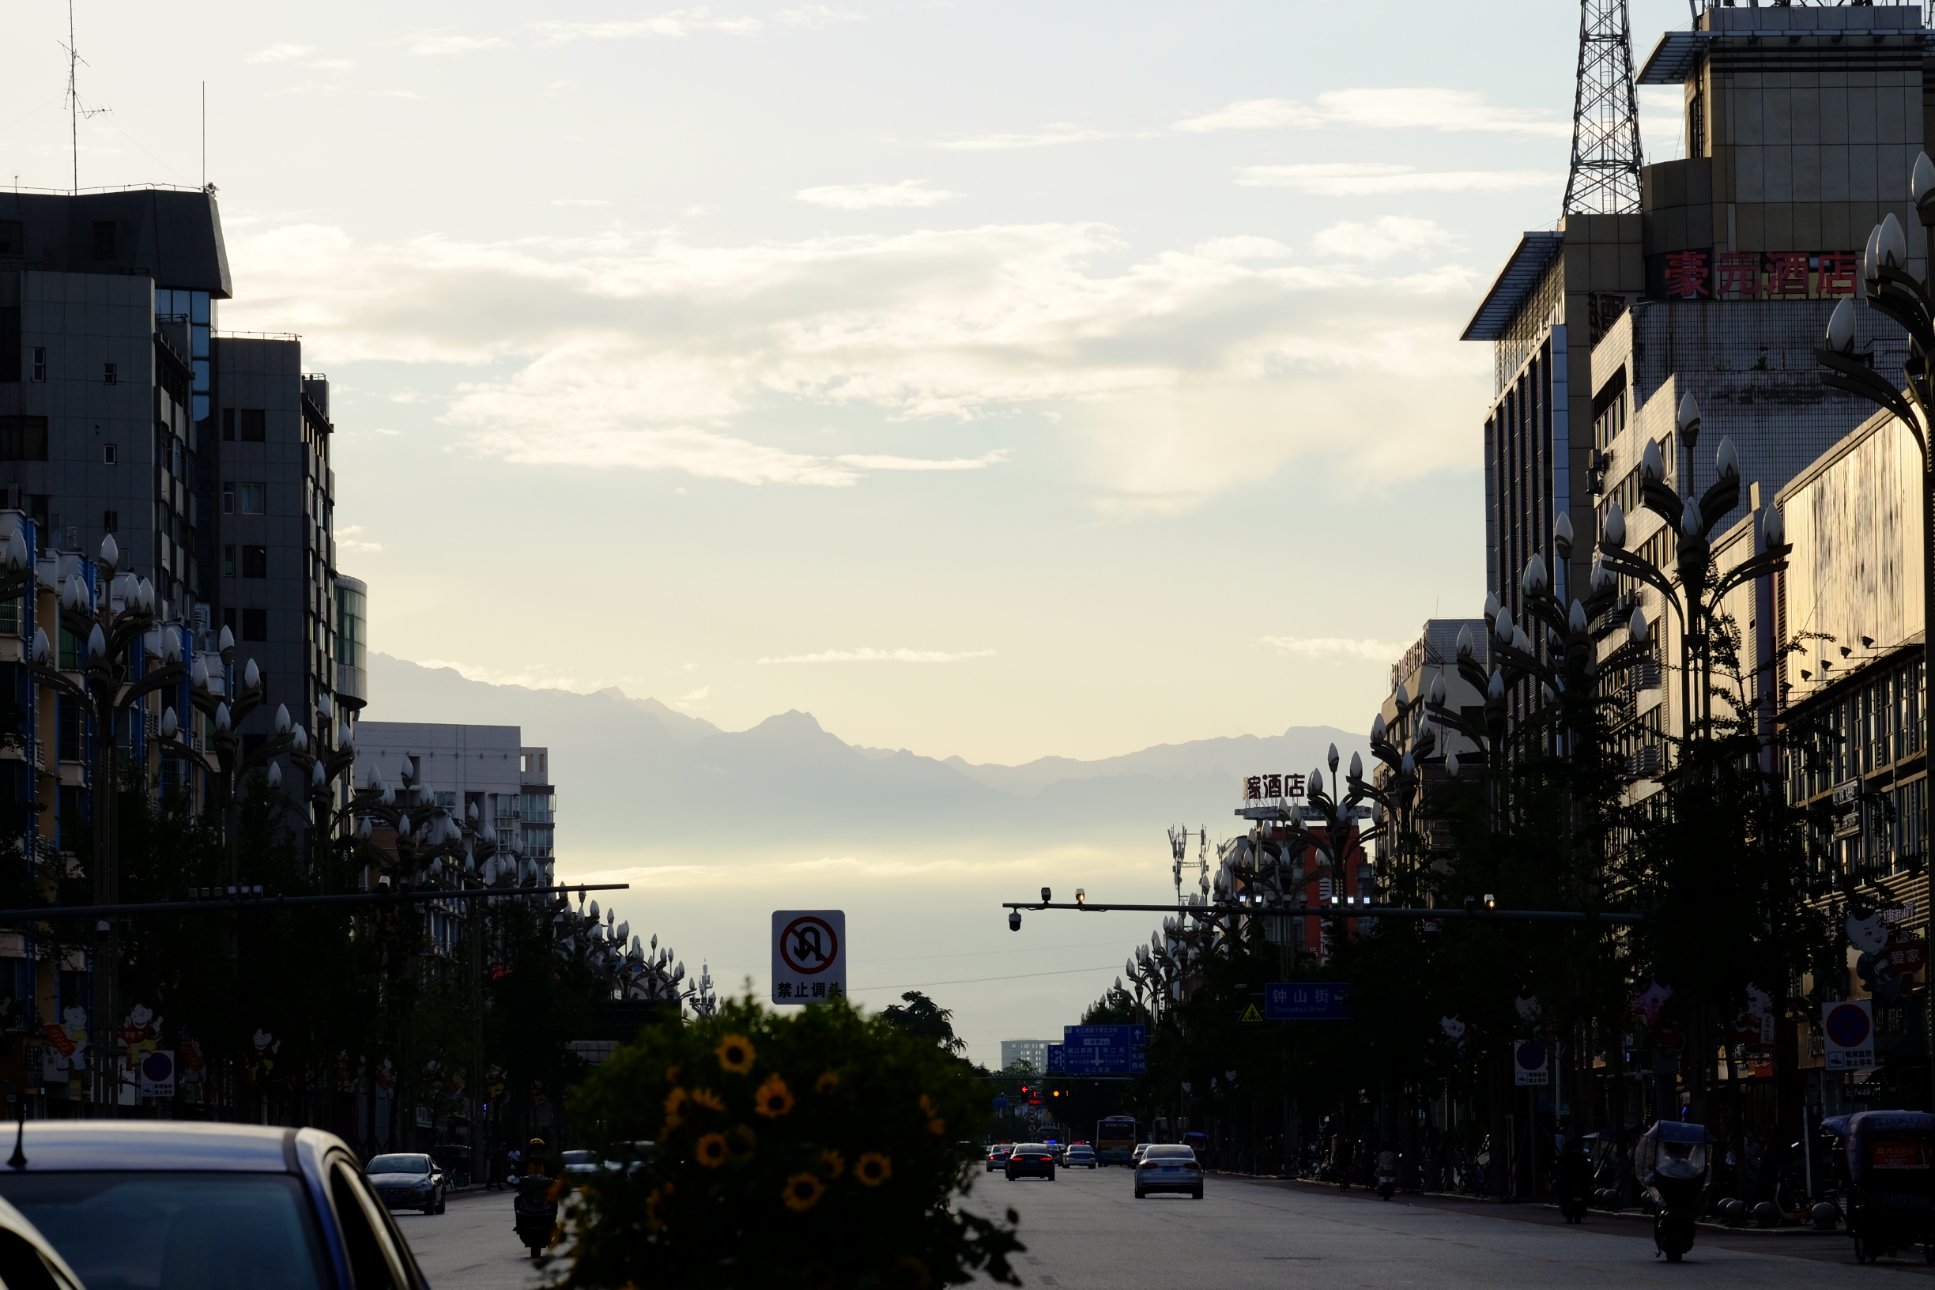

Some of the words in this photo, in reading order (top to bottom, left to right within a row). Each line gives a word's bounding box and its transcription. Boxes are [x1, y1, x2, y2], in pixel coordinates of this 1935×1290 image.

[1664, 251, 1857, 298] 豪元酒店
[1890, 949, 1921, 965] 爱家
[776, 982, 842, 998] 禁止调头
[1271, 988, 1330, 1004] 钟山街
